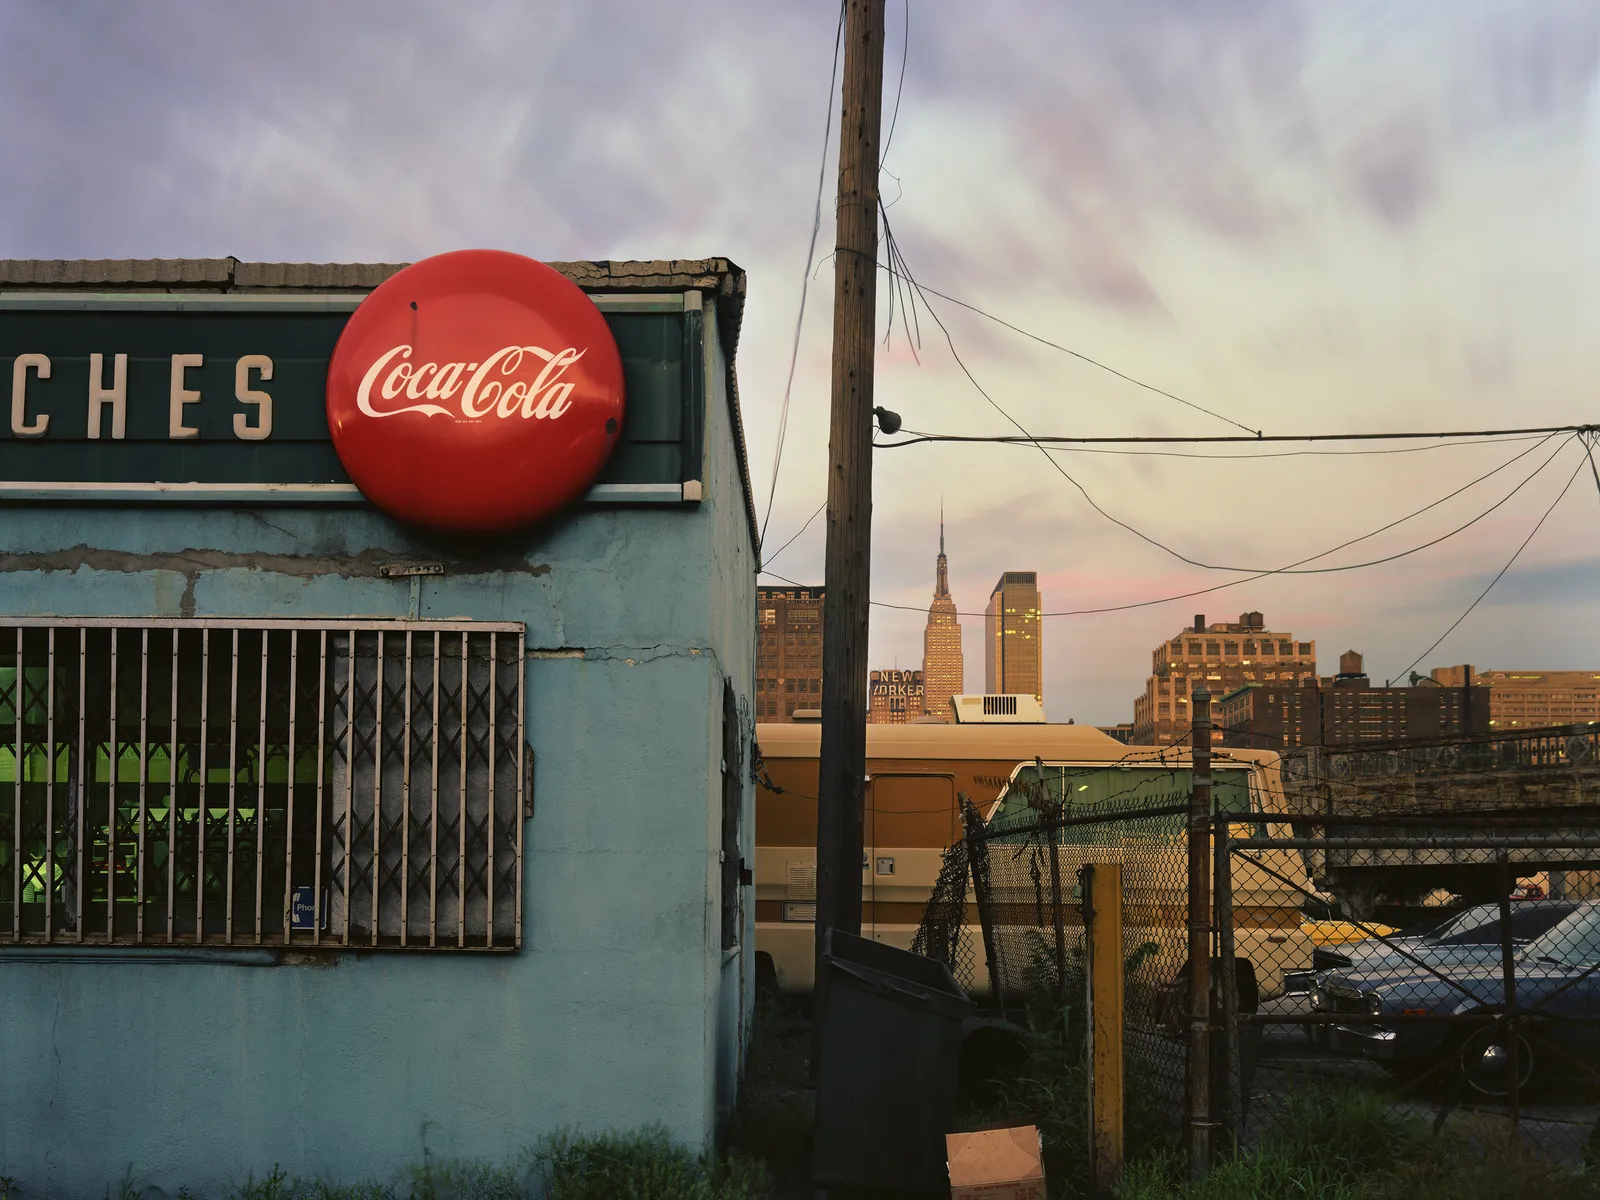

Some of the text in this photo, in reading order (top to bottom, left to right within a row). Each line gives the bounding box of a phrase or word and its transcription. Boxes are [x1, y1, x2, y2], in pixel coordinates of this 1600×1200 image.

[11, 353, 274, 440] CHES
[356, 344, 588, 420] Coca-Cola
[880, 671, 913, 682] NEW
